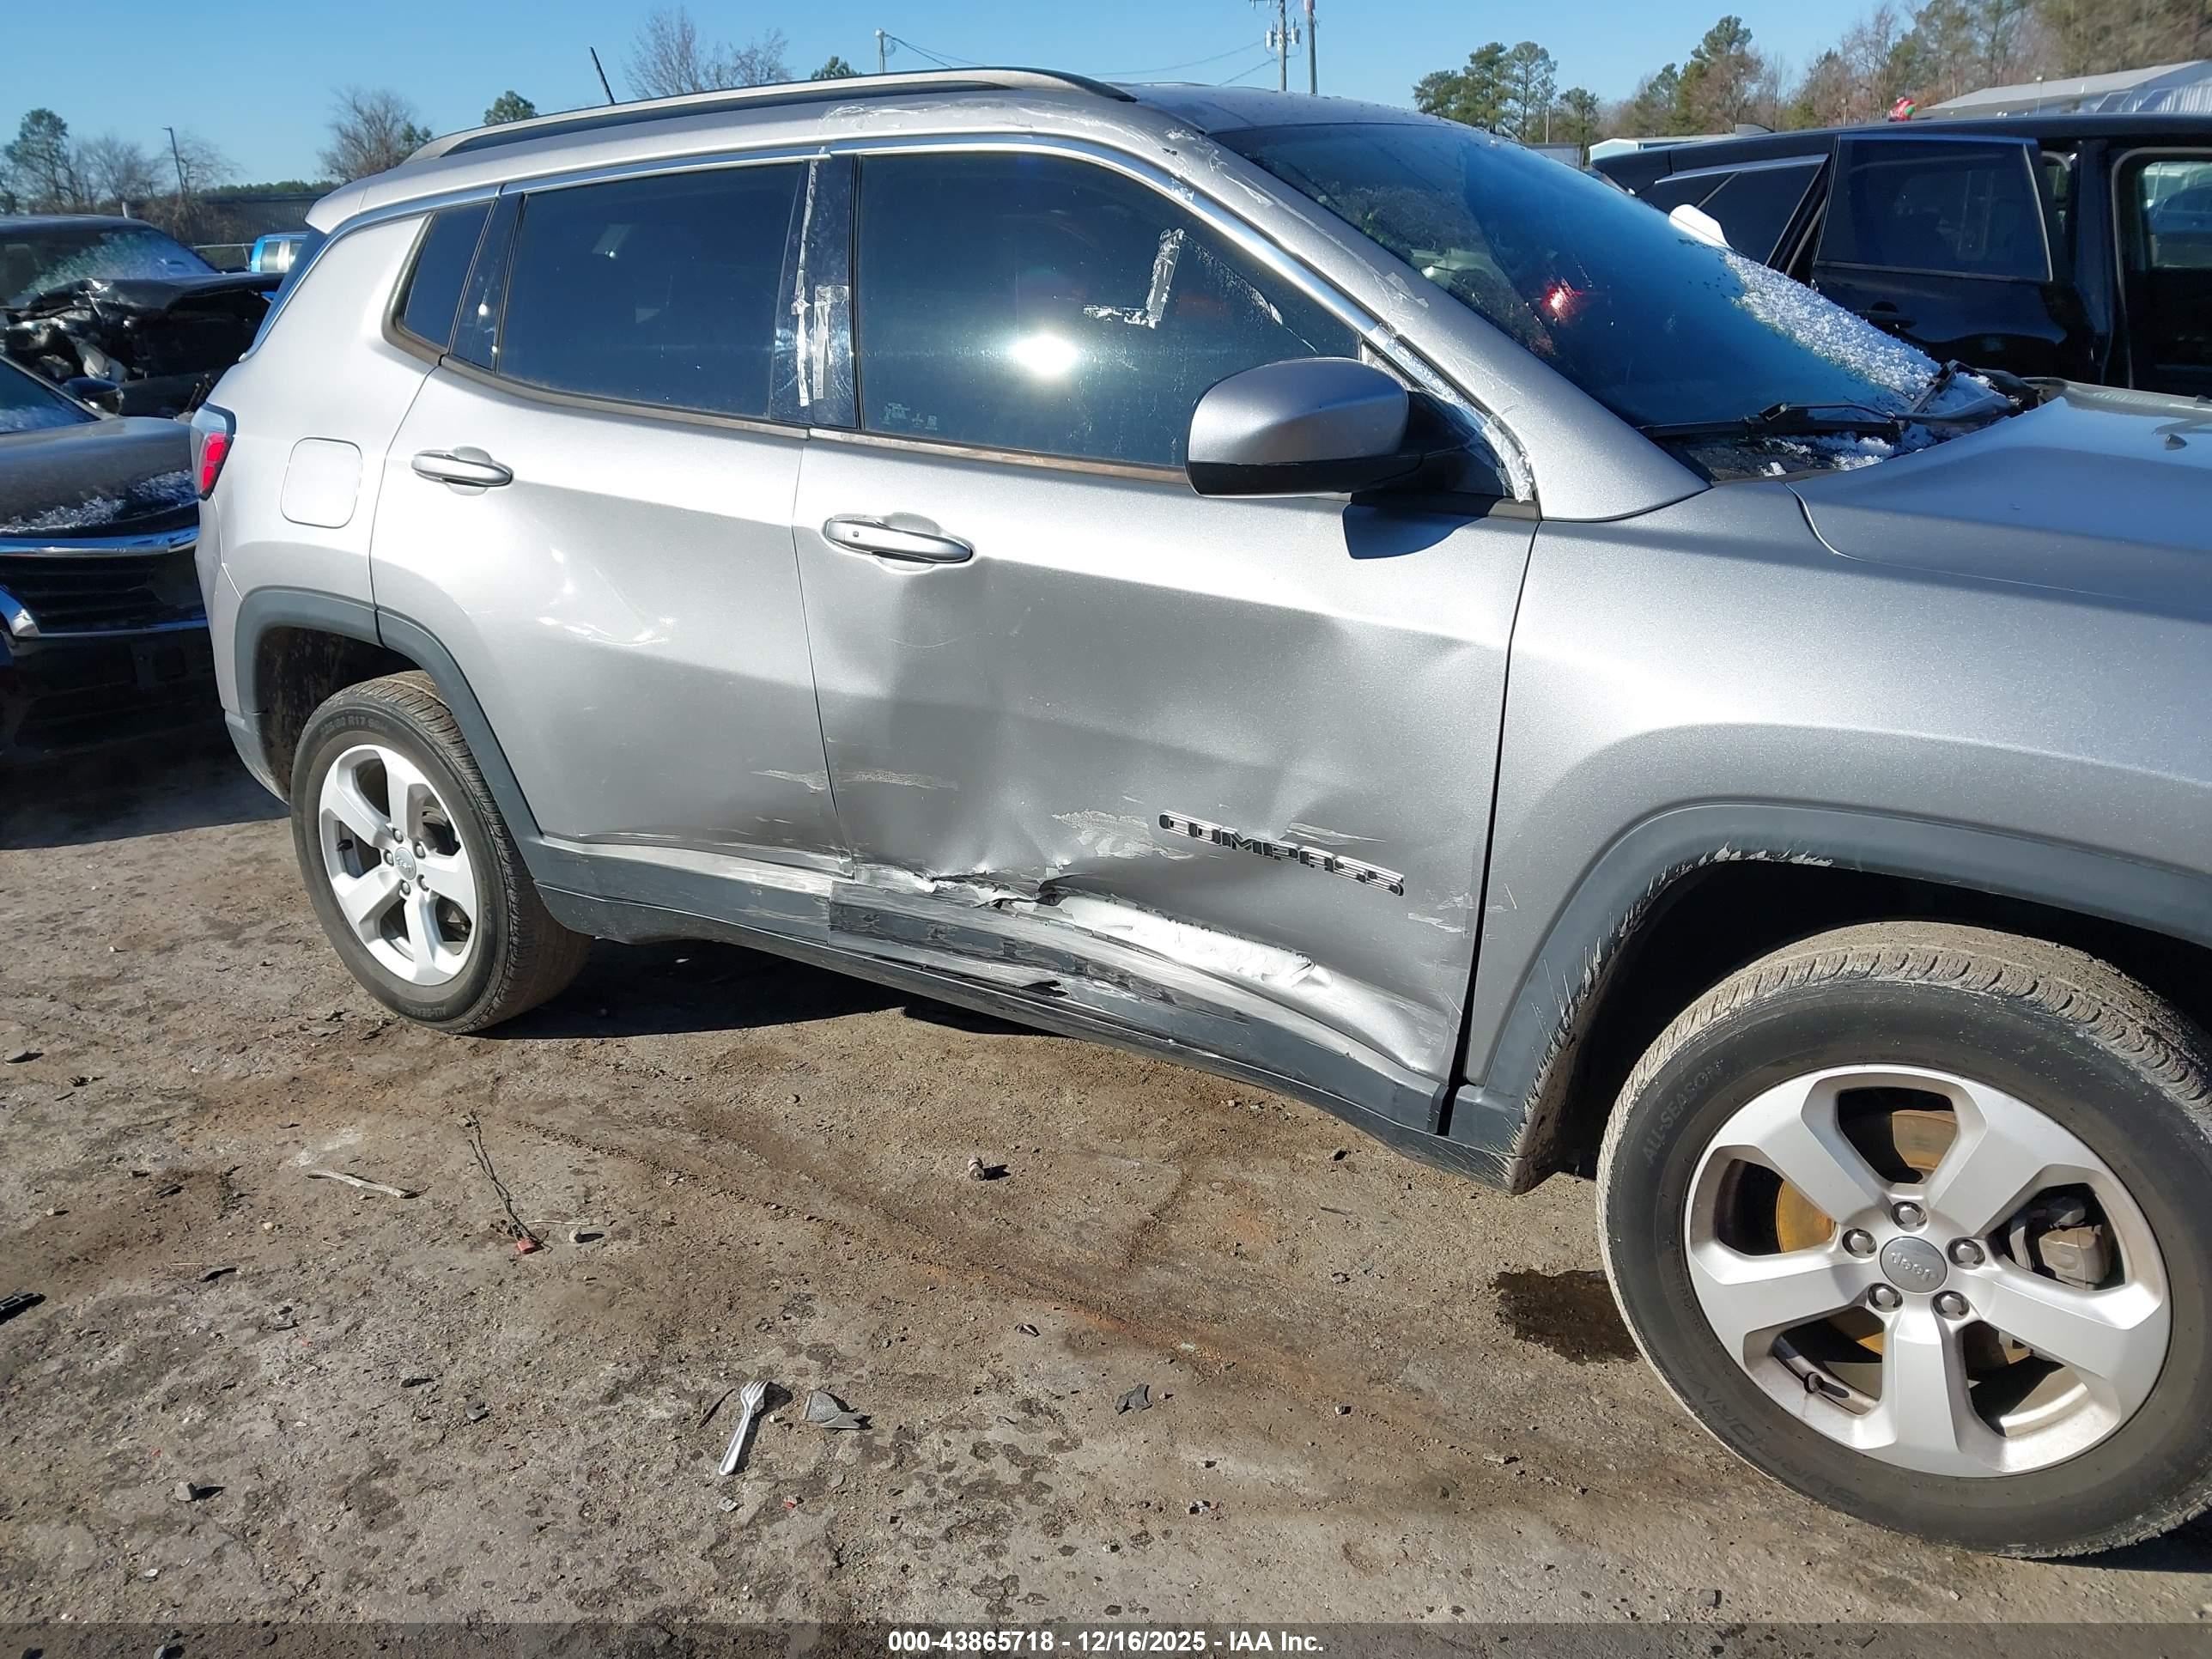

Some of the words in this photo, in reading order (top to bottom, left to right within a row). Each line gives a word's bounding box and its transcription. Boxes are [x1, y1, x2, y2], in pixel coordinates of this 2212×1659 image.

[1158, 810, 1405, 897] COMPASS
[1640, 1059, 1725, 1167] ALL-SEASON
[1889, 1251, 1939, 1283] Jeep
